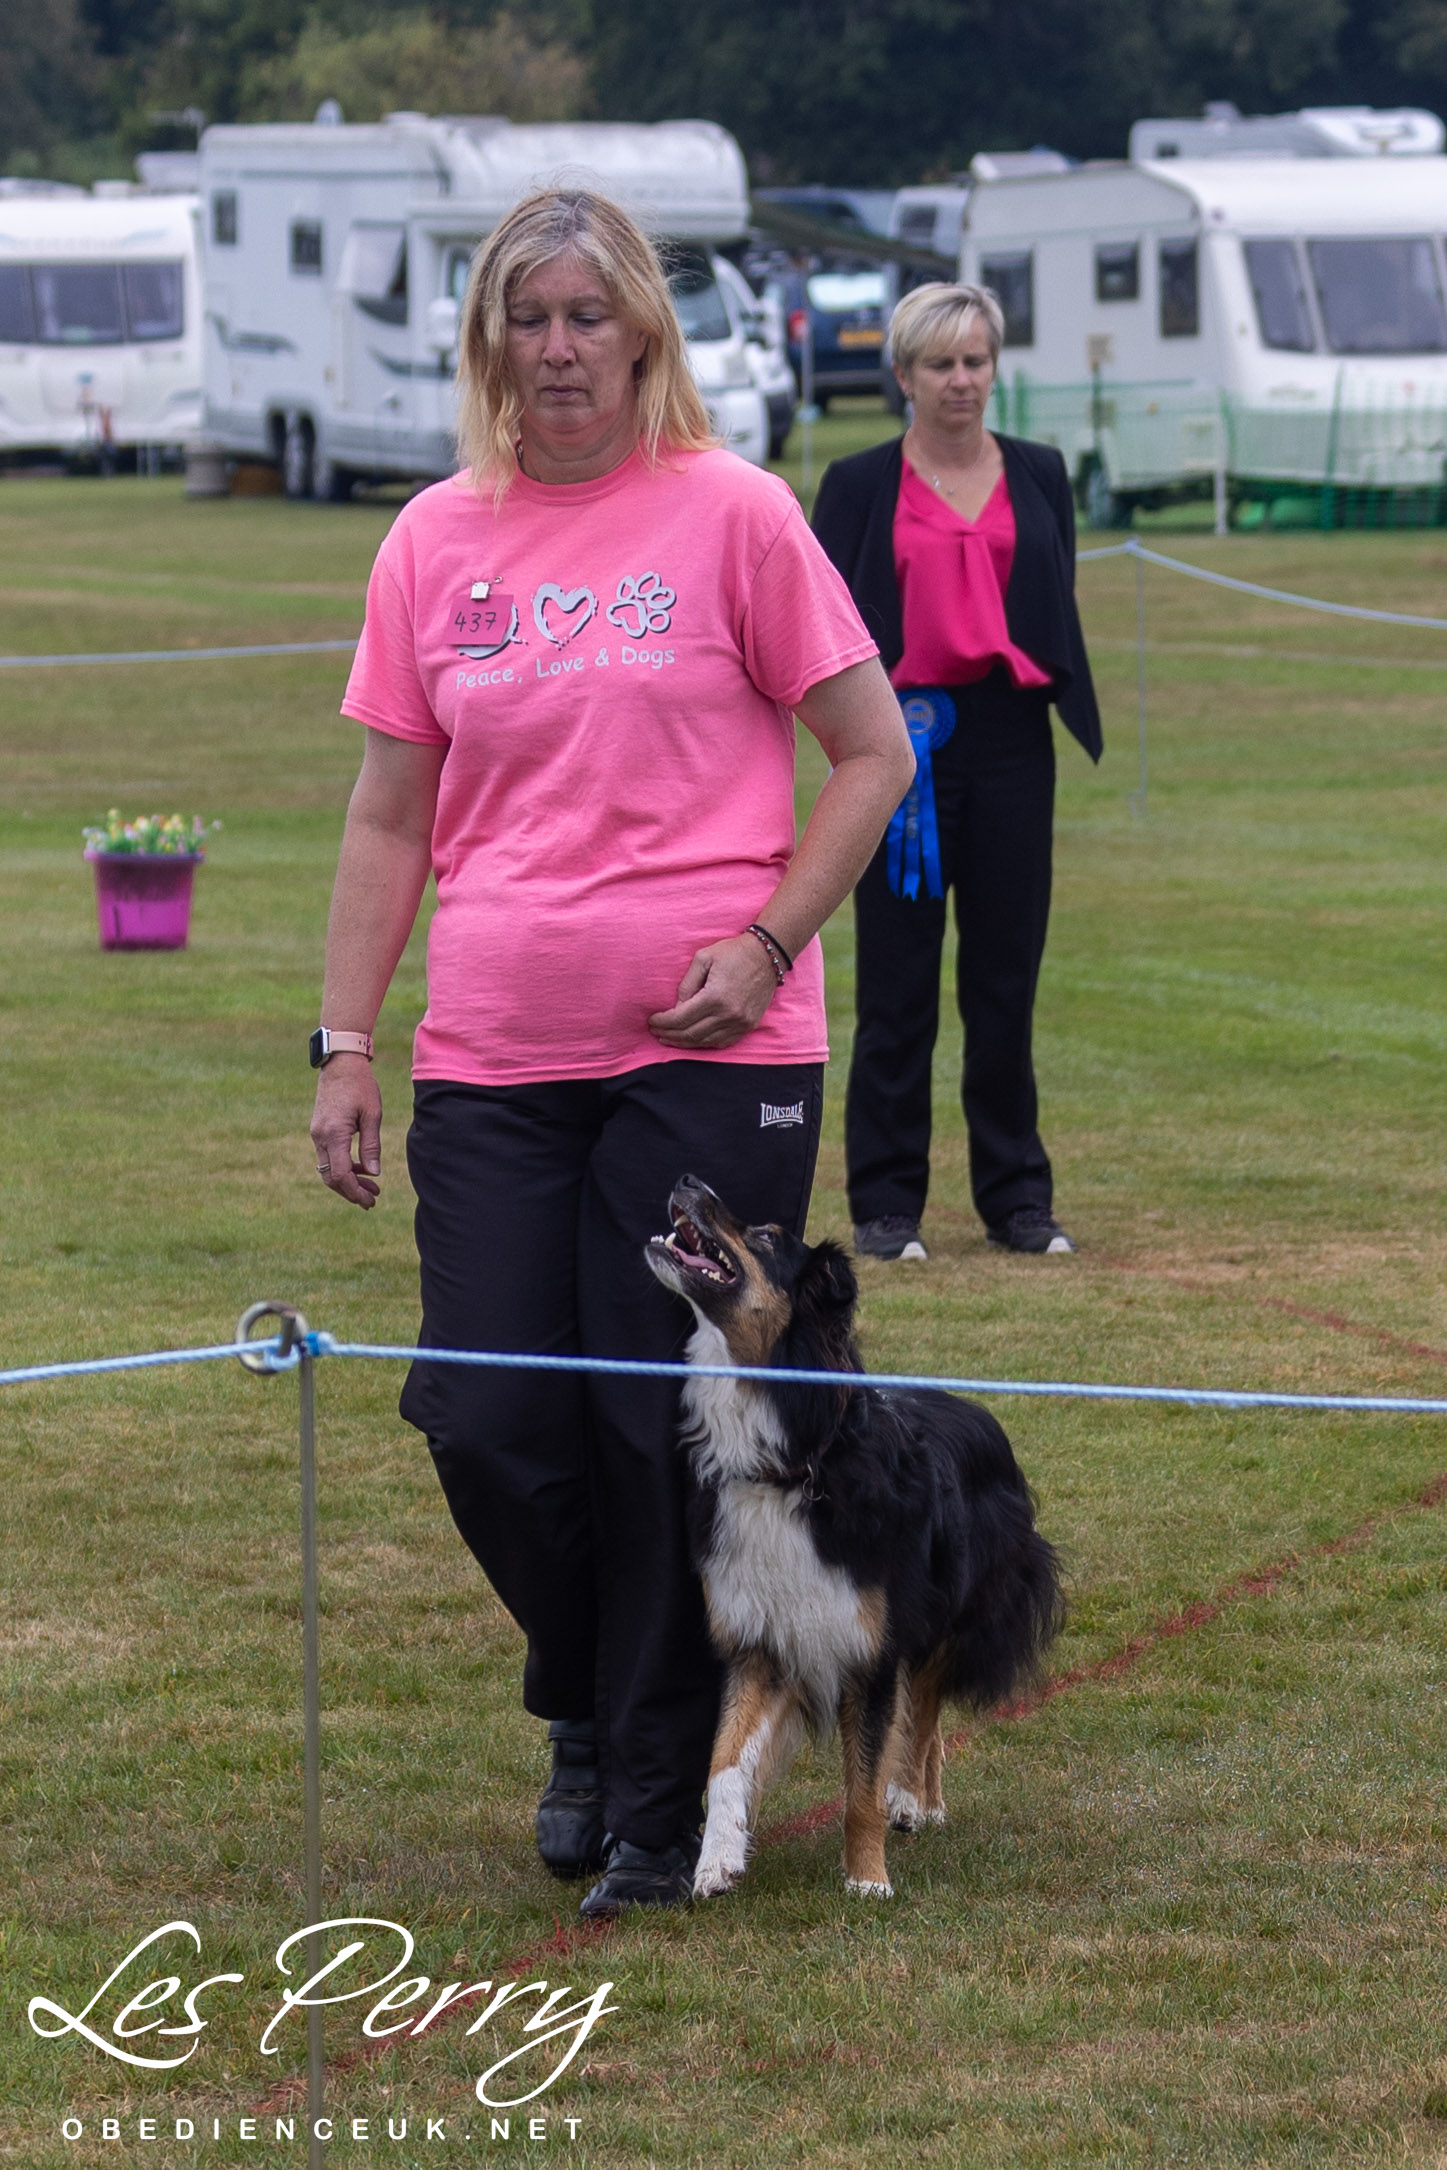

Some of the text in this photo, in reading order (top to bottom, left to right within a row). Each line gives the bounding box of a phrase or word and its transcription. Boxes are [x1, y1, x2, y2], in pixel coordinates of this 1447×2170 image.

[453, 611, 498, 633] 437
[456, 646, 675, 690] Peace, Love & Dogs
[760, 1100, 804, 1127] LONSDALE
